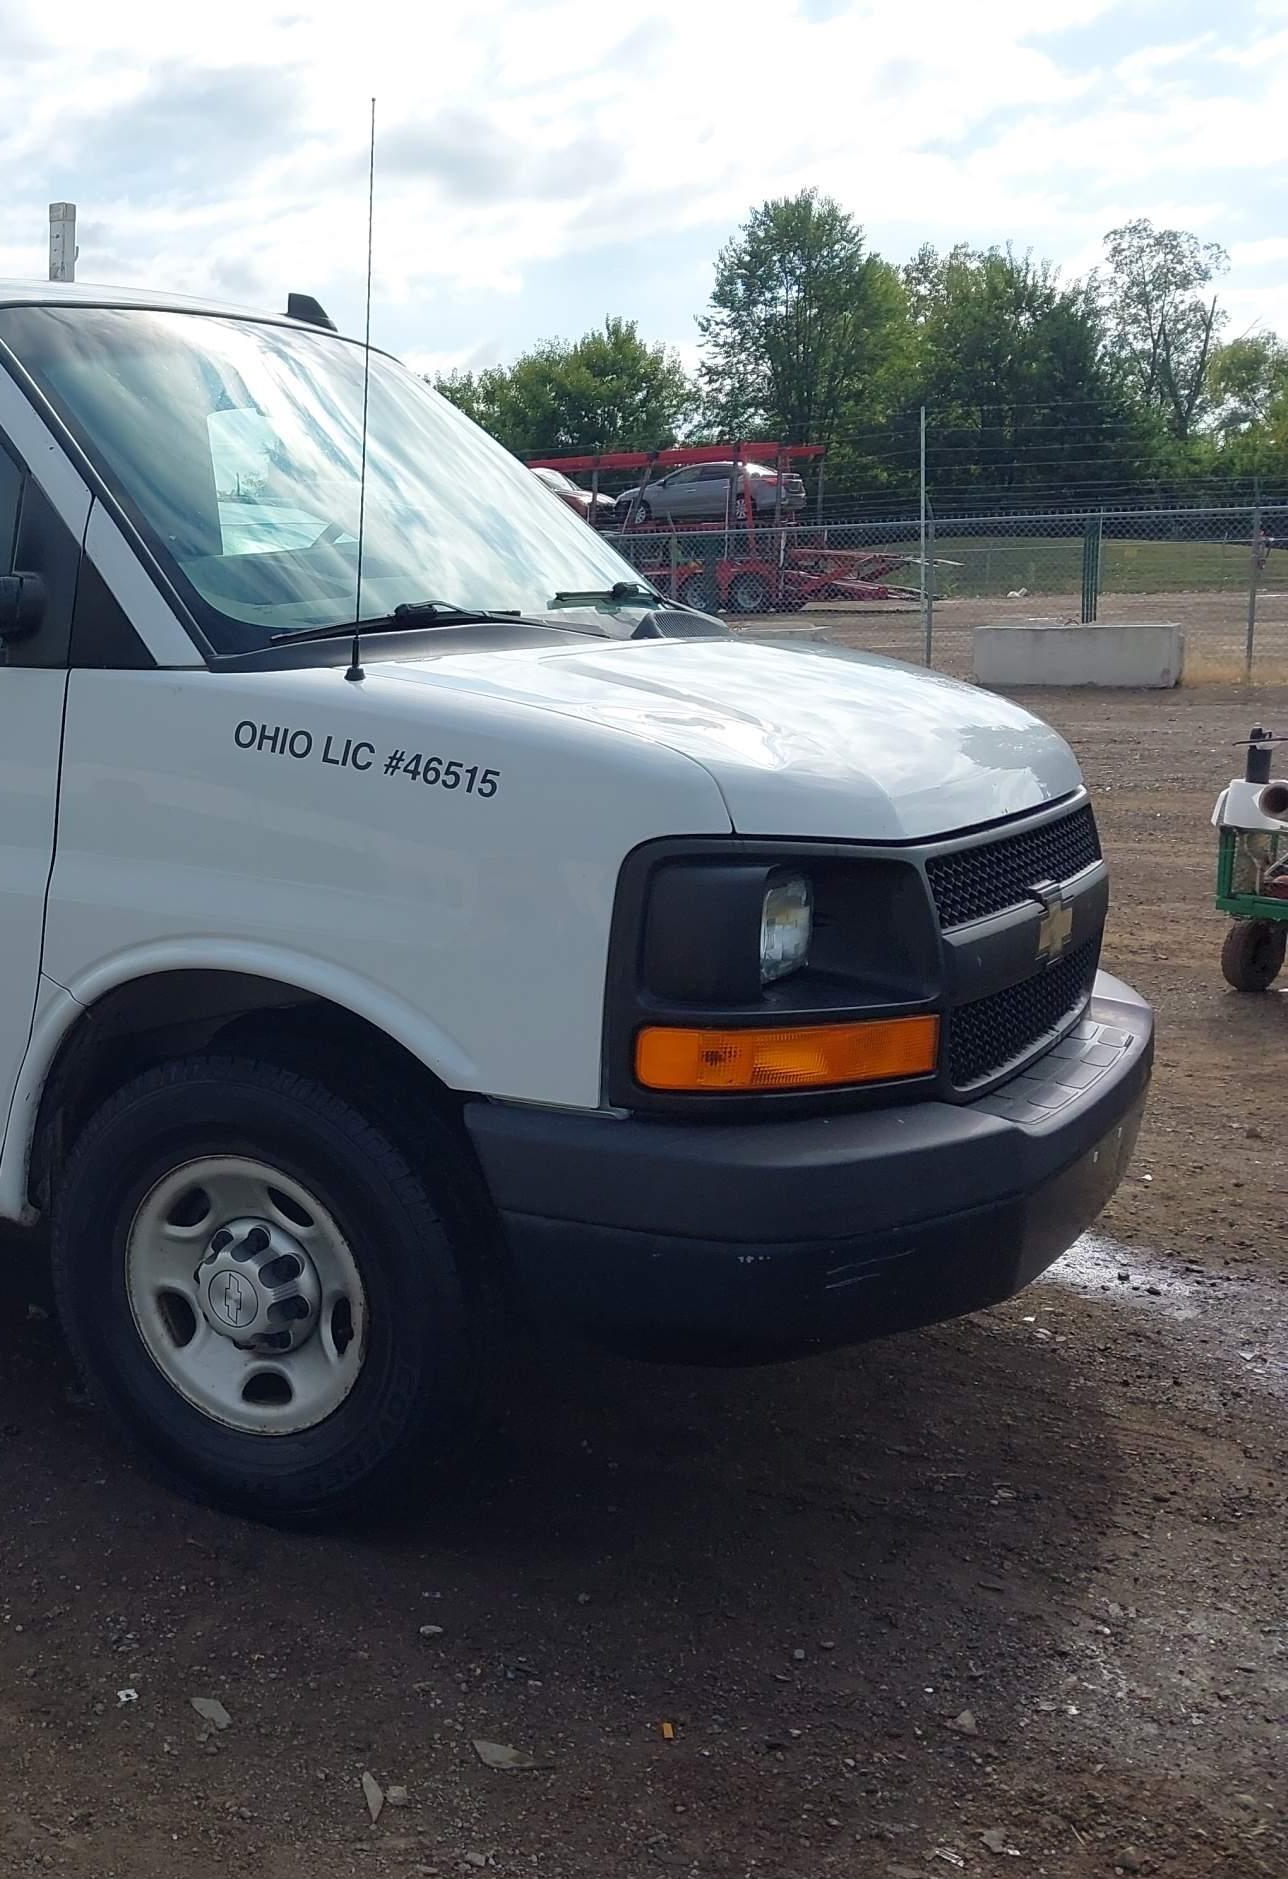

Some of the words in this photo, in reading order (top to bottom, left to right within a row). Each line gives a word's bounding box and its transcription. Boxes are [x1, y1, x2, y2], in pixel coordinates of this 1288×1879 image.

[234, 720, 313, 759] OHIO
[321, 735, 376, 771] LIC
[383, 749, 501, 798] #46515
